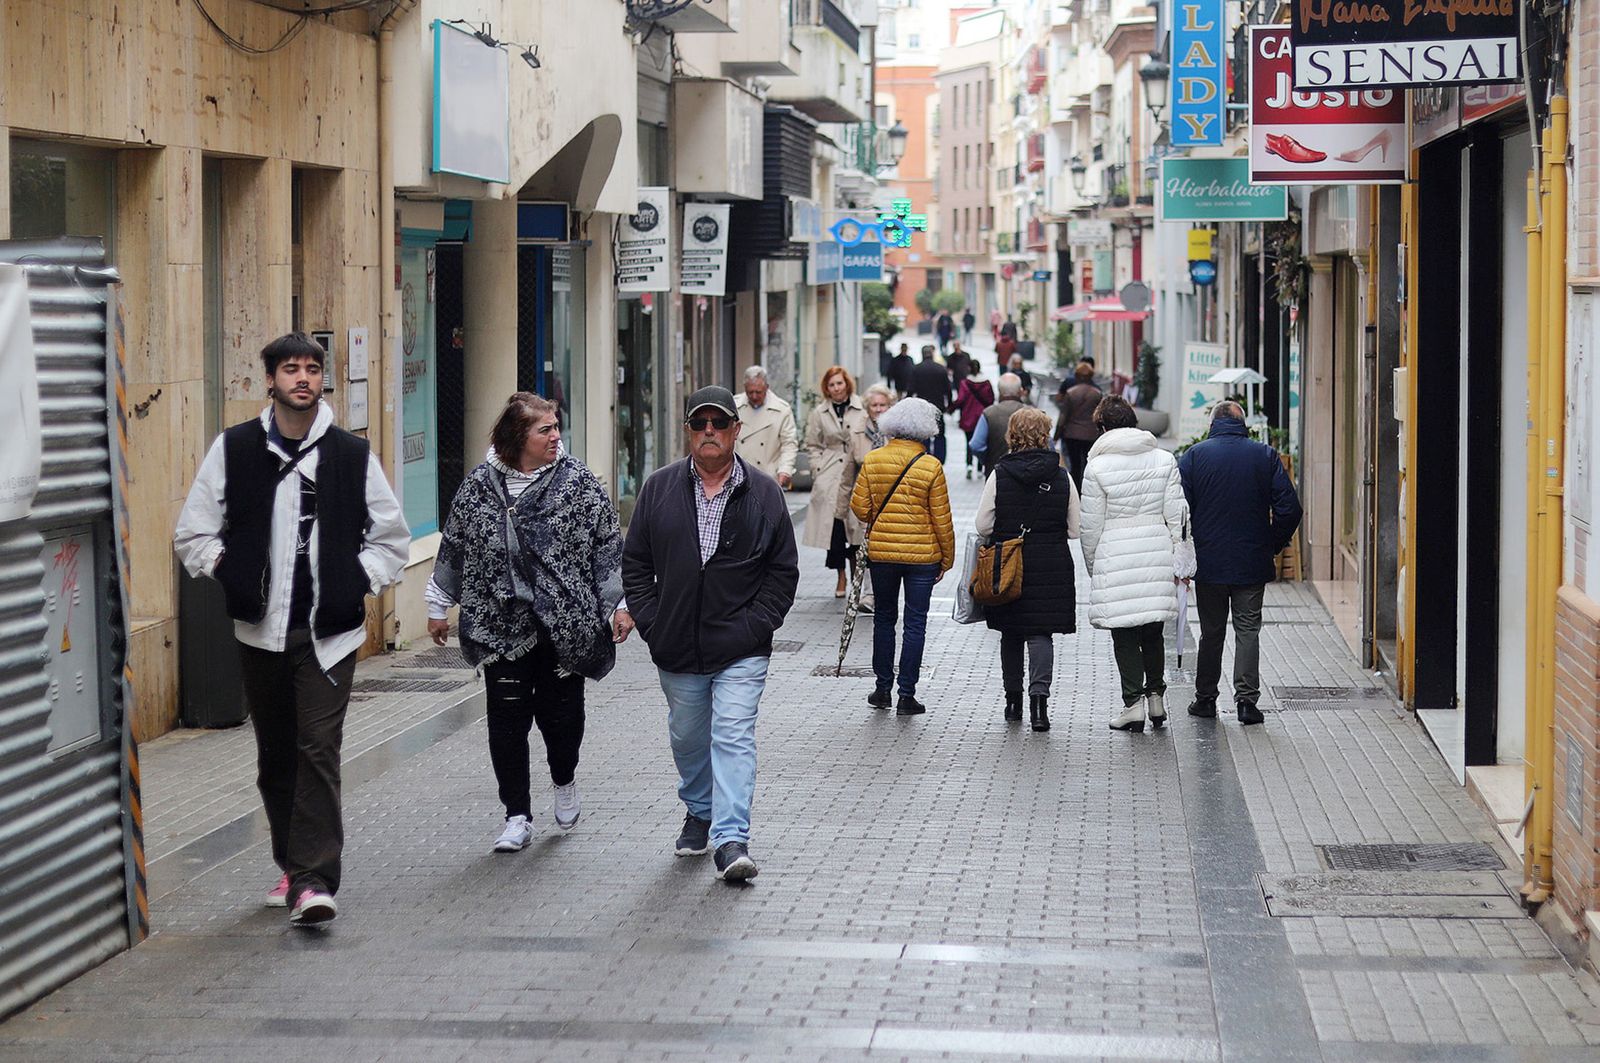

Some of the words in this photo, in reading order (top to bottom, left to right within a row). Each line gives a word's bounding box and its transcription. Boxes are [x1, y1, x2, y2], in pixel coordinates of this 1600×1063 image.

[1178, 4, 1218, 140] LADY
[1307, 43, 1508, 86] SENSAI
[1166, 178, 1274, 198] Hierbaluisa
[844, 255, 881, 268] GAFAS
[1190, 351, 1222, 365] Little
